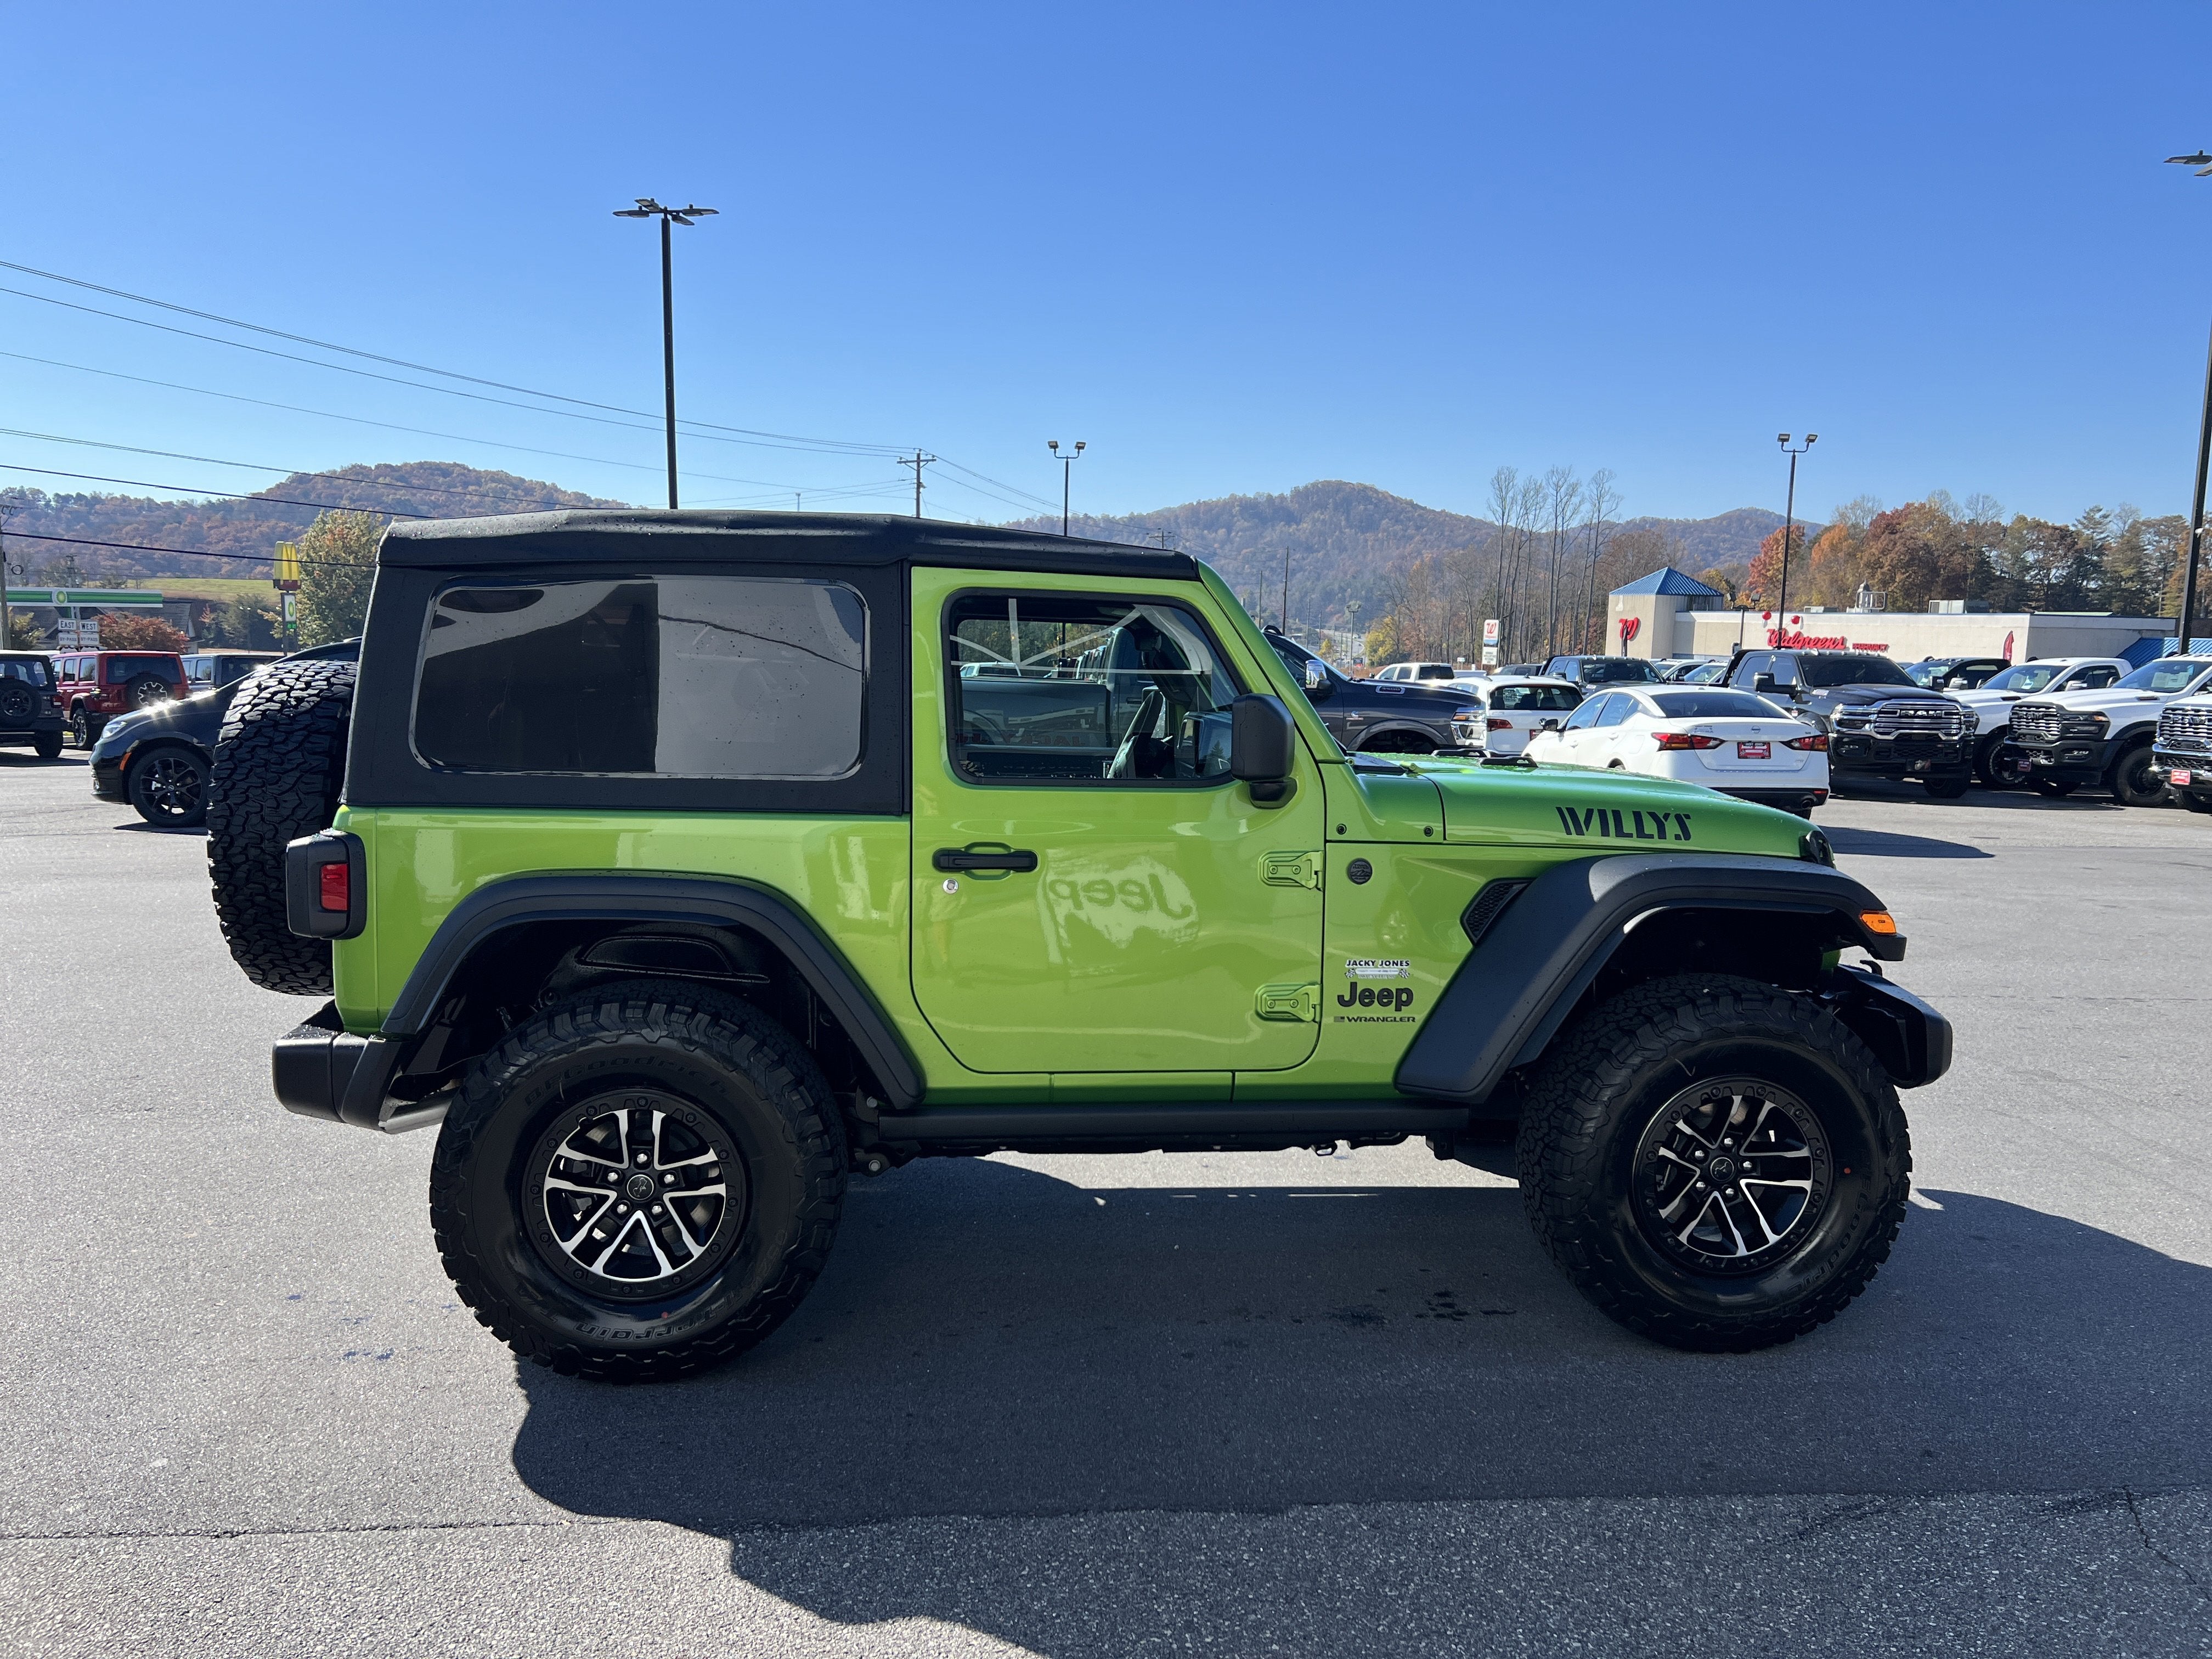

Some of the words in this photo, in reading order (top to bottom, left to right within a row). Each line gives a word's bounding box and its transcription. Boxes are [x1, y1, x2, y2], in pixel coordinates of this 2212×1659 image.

[60, 620, 75, 629] EAST
[81, 622, 96, 630] WEST
[1486, 622, 1496, 634] W
[1767, 628, 1847, 650] Walgreens
[1555, 806, 1691, 841] WILLYS
[1337, 981, 1413, 1012] Jeep
[524, 1054, 729, 1107] BFGoodrich
